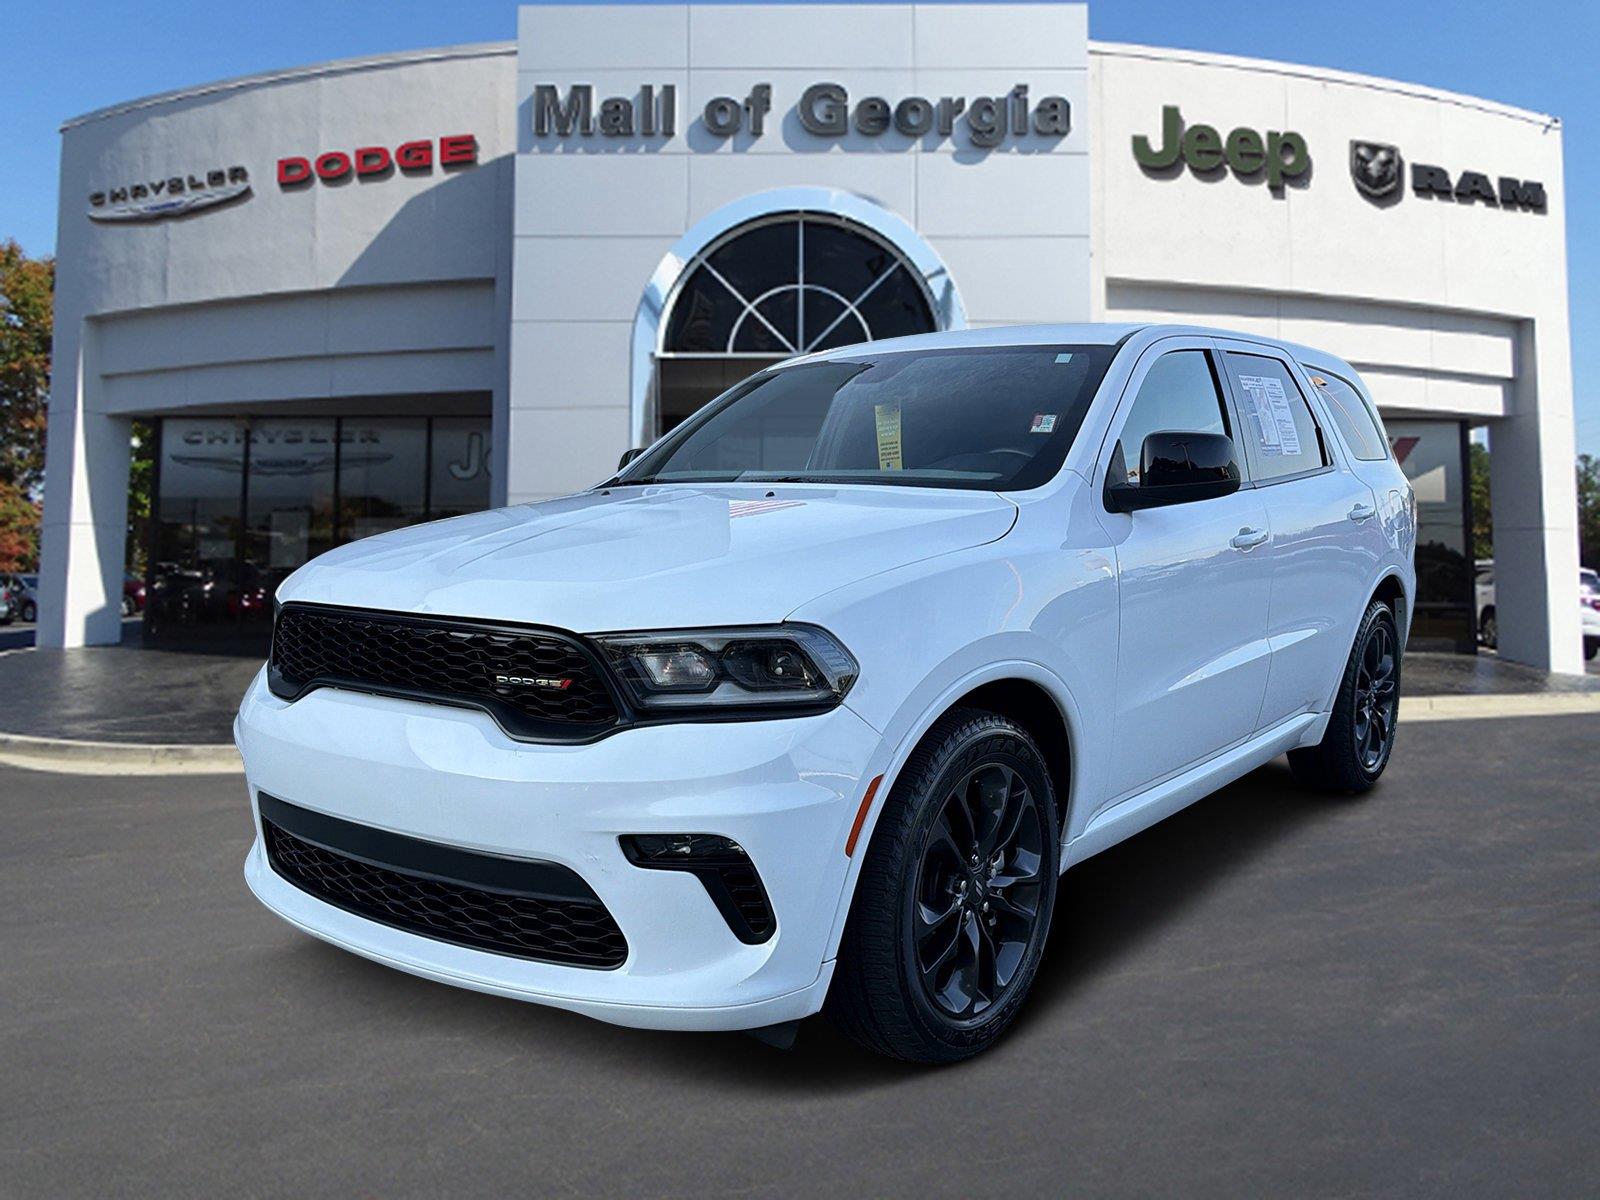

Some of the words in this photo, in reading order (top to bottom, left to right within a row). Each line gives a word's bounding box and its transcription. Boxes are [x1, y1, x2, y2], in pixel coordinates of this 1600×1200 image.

[533, 84, 677, 136] Mall
[703, 84, 772, 135] of
[799, 83, 1072, 148] Georgia
[277, 134, 476, 185] DODGE
[1131, 105, 1308, 188] Jeep
[89, 166, 249, 206] CHRYSLER
[1411, 163, 1544, 210] RAM
[496, 675, 562, 687] DODGE
